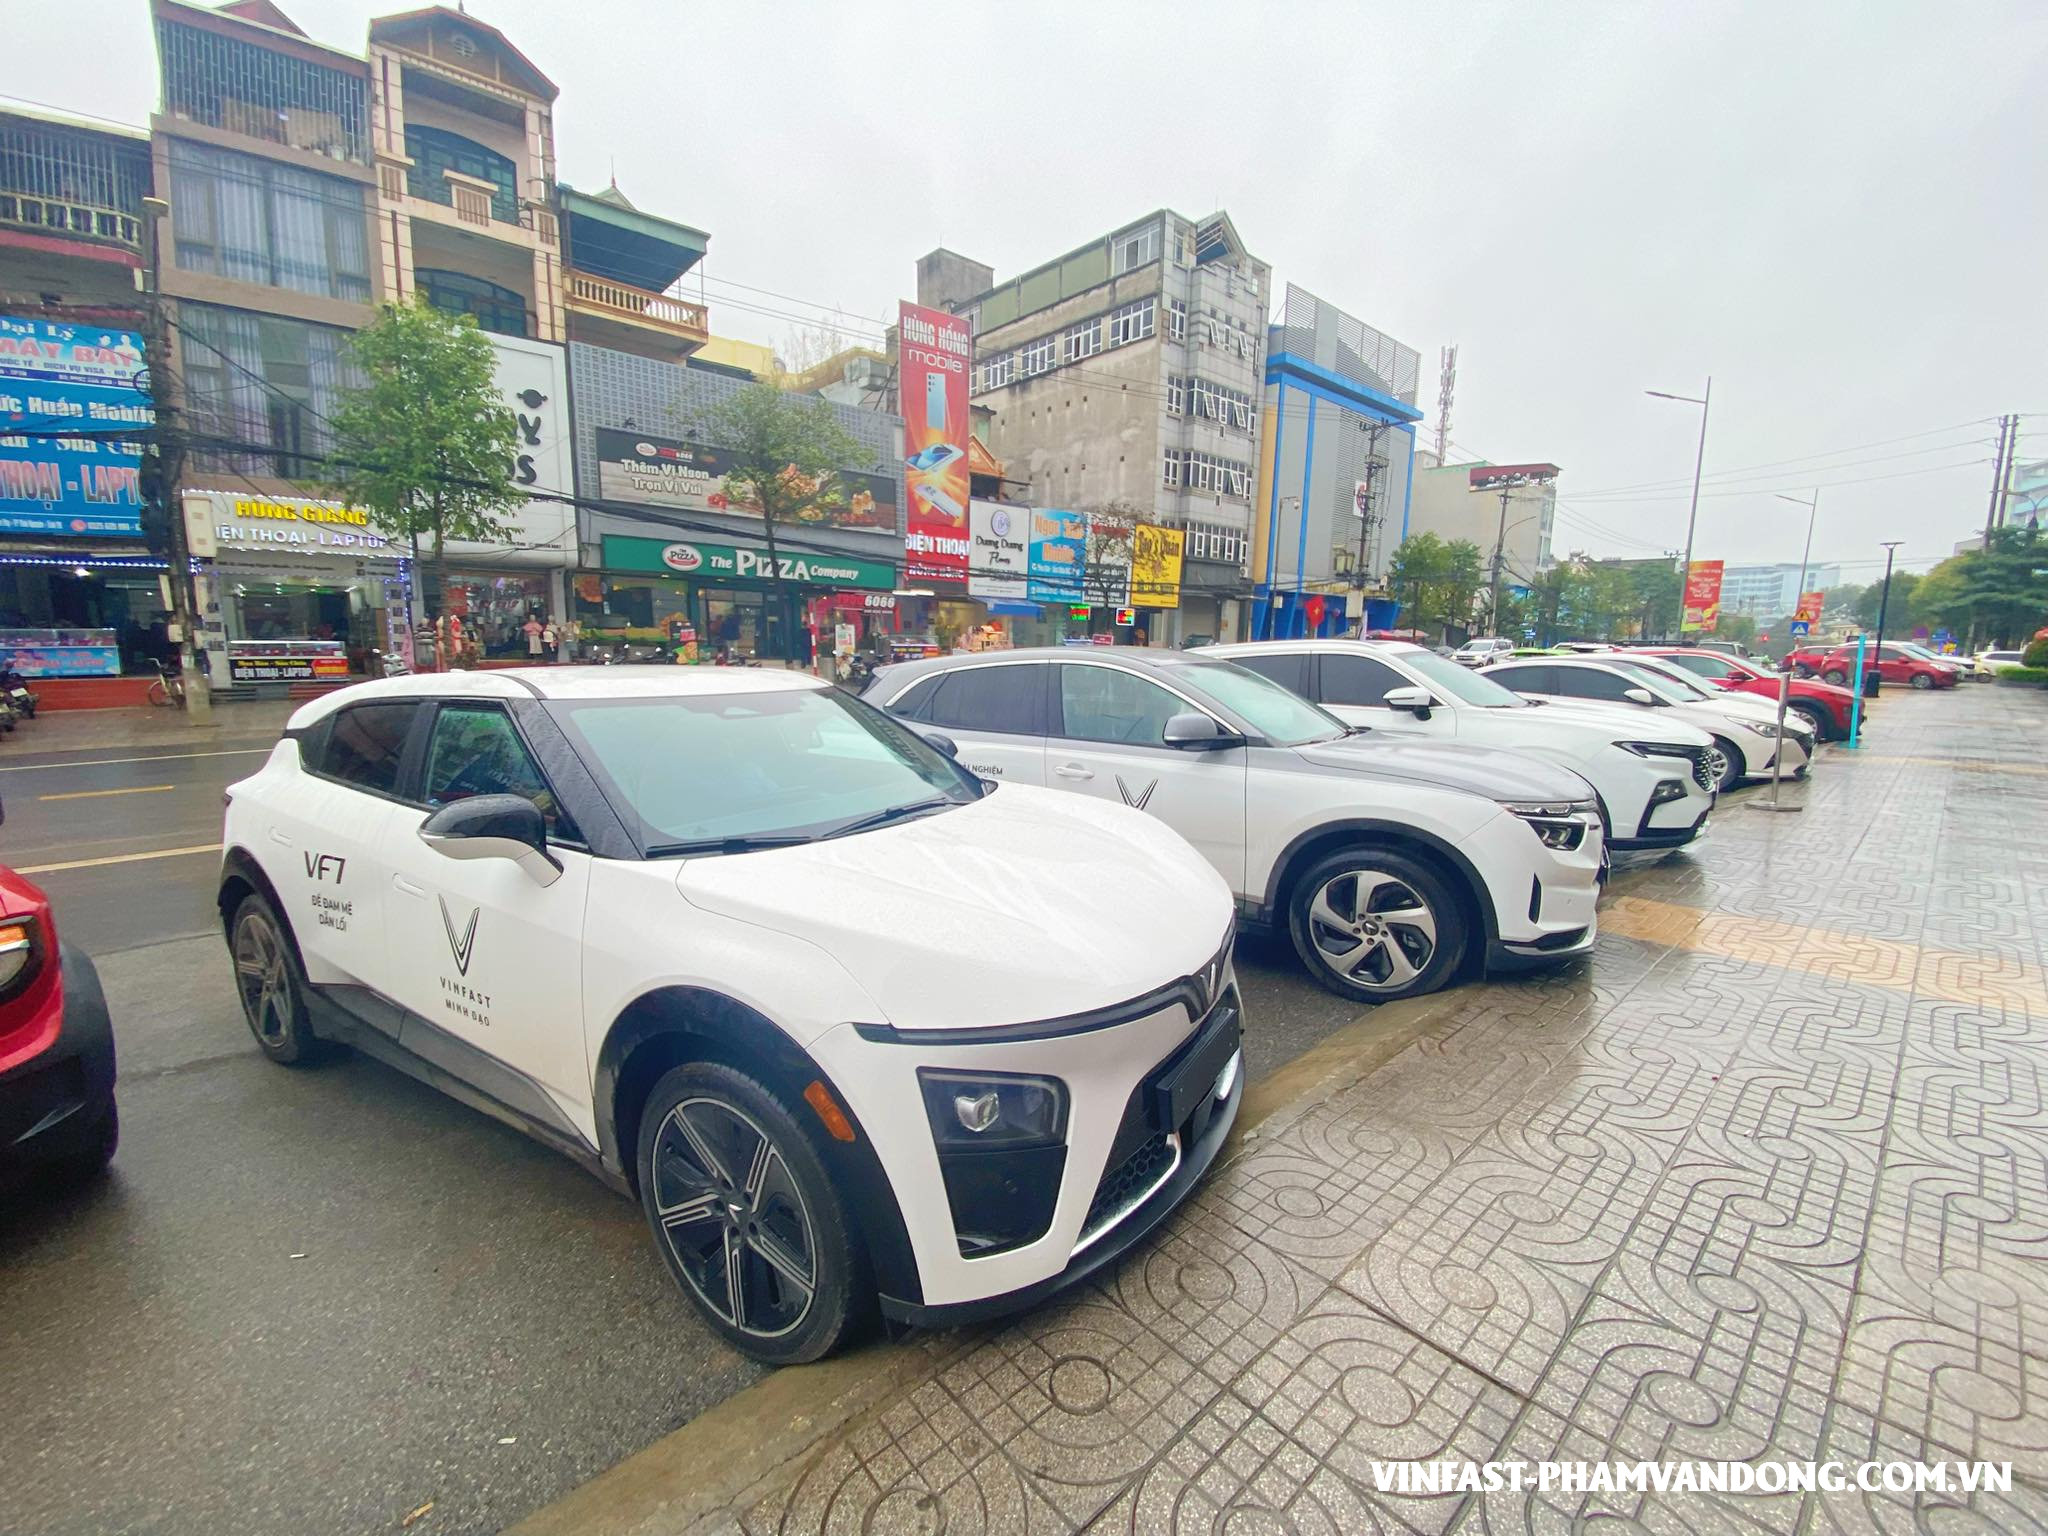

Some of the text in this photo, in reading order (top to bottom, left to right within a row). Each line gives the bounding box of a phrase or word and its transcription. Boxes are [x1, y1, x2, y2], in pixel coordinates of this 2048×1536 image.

[903, 313, 935, 347] HÙNG
[72, 345, 136, 368] BAY
[908, 348, 963, 373] mobile
[621, 459, 660, 476] Thêm
[632, 477, 661, 494] Trọn
[681, 482, 703, 496] Vui
[235, 499, 368, 527] HÙNG GIANG
[215, 523, 244, 543] IỆN
[250, 528, 307, 547] THOẠI
[319, 531, 387, 549] LAPTOP
[905, 529, 970, 560] ĐIỆN THOẠI
[710, 555, 733, 569] The
[735, 549, 811, 581] PIZZA
[810, 564, 859, 580] Company
[440, 976, 491, 1009] VINFAST
[445, 999, 469, 1017] MINH
